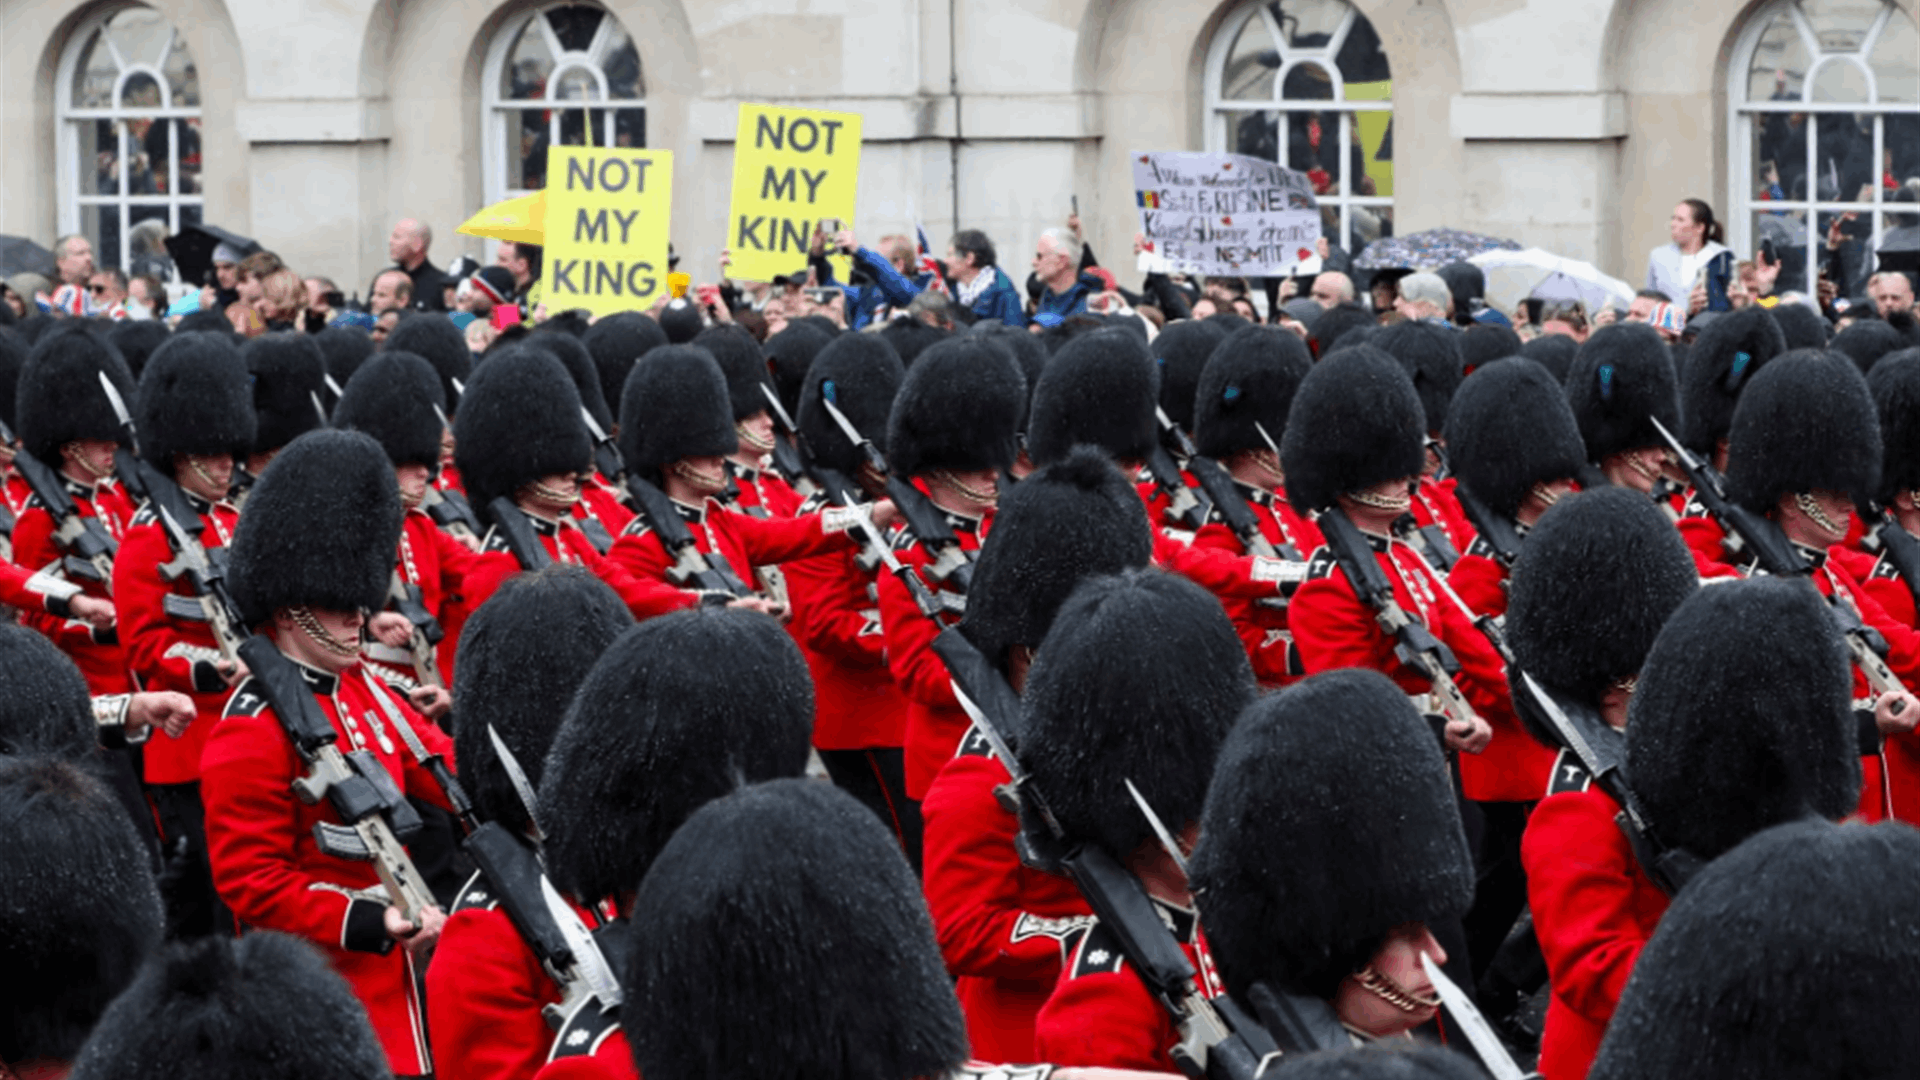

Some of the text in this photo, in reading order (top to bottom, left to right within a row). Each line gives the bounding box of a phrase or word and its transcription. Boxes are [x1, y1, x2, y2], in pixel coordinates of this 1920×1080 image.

[755, 114, 843, 155] NOT
[566, 156, 653, 193] NOT
[760, 166, 827, 204] MY
[573, 208, 640, 245] MY
[738, 215, 835, 255] KIN
[552, 259, 657, 297] KING
